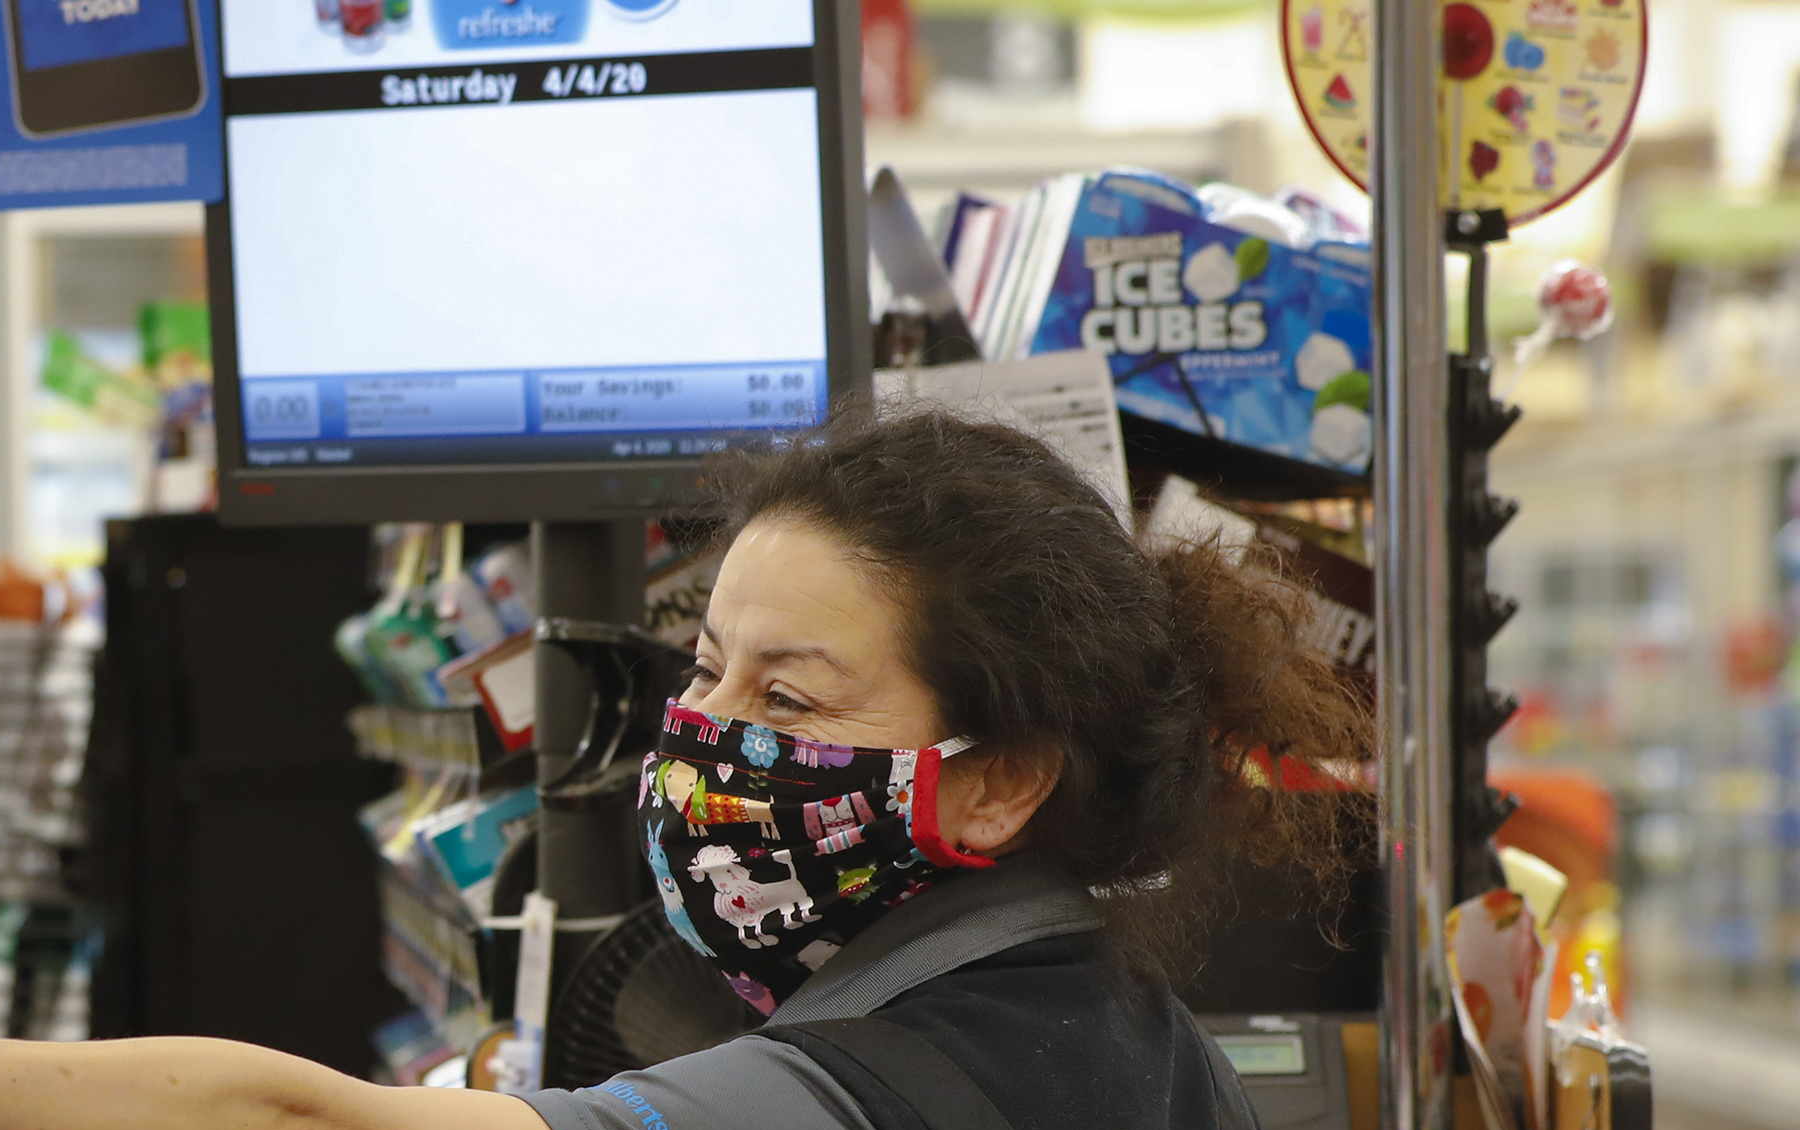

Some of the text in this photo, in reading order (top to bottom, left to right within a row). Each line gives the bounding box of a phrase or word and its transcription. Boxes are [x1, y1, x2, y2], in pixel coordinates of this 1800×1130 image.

[61, 0, 139, 25] TODAY
[381, 62, 647, 105] Saturday 4/4/20
[1093, 260, 1182, 308] ICE
[1081, 302, 1267, 355] CUBES
[1178, 353, 1280, 372] EPPERMINT
